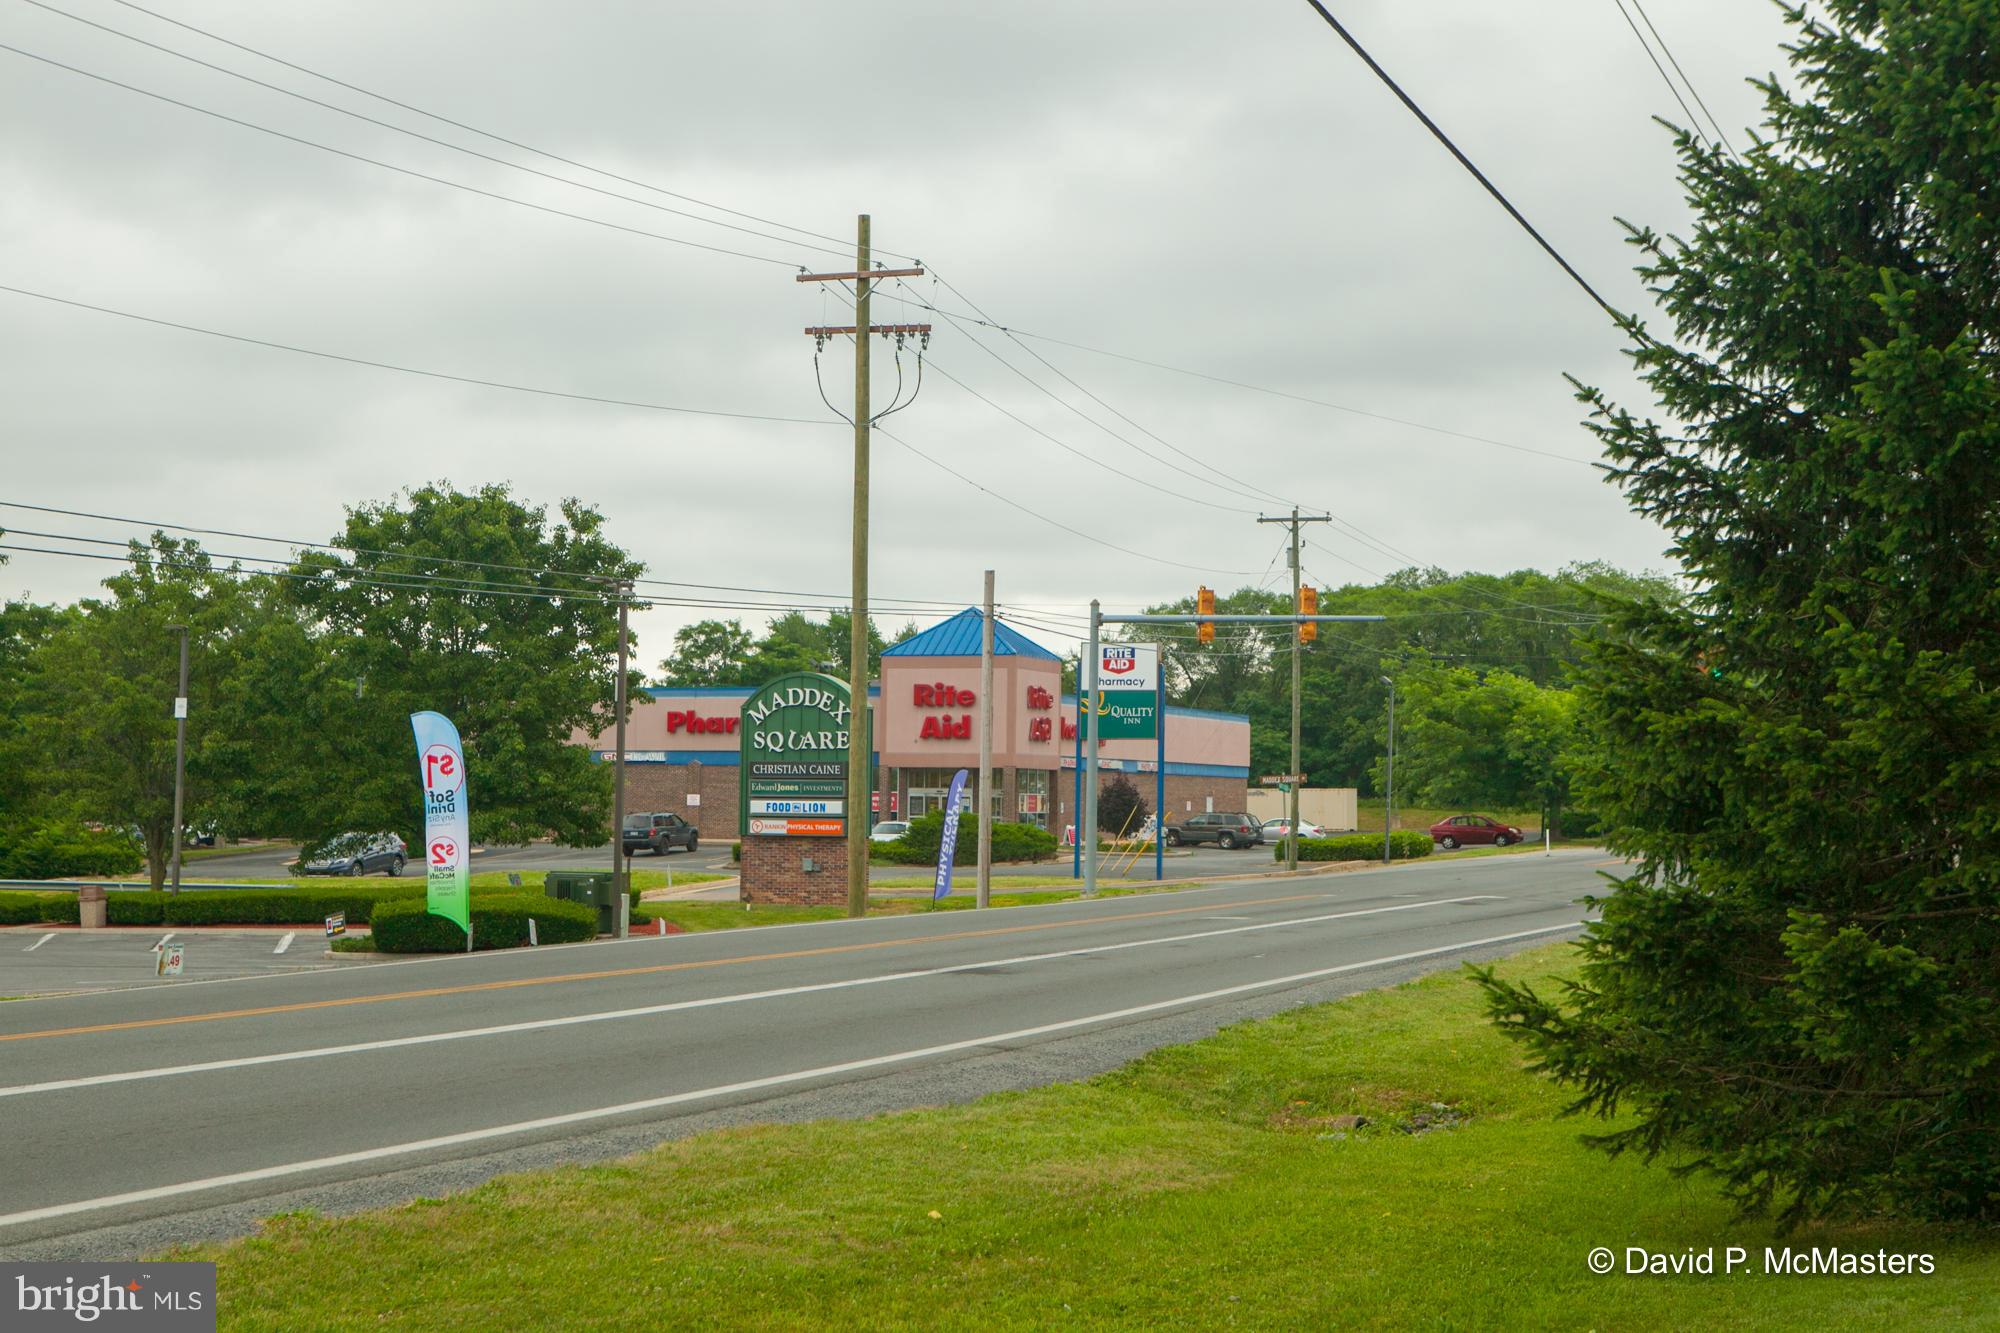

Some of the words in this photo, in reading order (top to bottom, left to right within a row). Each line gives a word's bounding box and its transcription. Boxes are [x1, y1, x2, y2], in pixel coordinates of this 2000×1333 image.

[1106, 648, 1132, 658] RITE
[1109, 660, 1130, 670] AID
[1098, 677, 1145, 687] harmacy
[913, 682, 976, 708] Rite
[1027, 685, 1054, 710] Rite
[747, 687, 851, 726] MADDEX
[1111, 705, 1154, 718] QUALITY
[667, 709, 740, 735] Phar
[919, 714, 972, 740] Aid
[1124, 717, 1141, 725] INN
[753, 729, 850, 753] SQUARE
[752, 764, 806, 775] CHRISTIAN
[809, 764, 841, 775] CAINE
[766, 802, 791, 813] FOOD
[802, 802, 827, 813] LION
[787, 823, 815, 831] PHYSICAL
[937, 808, 955, 886] PHYSICAL
